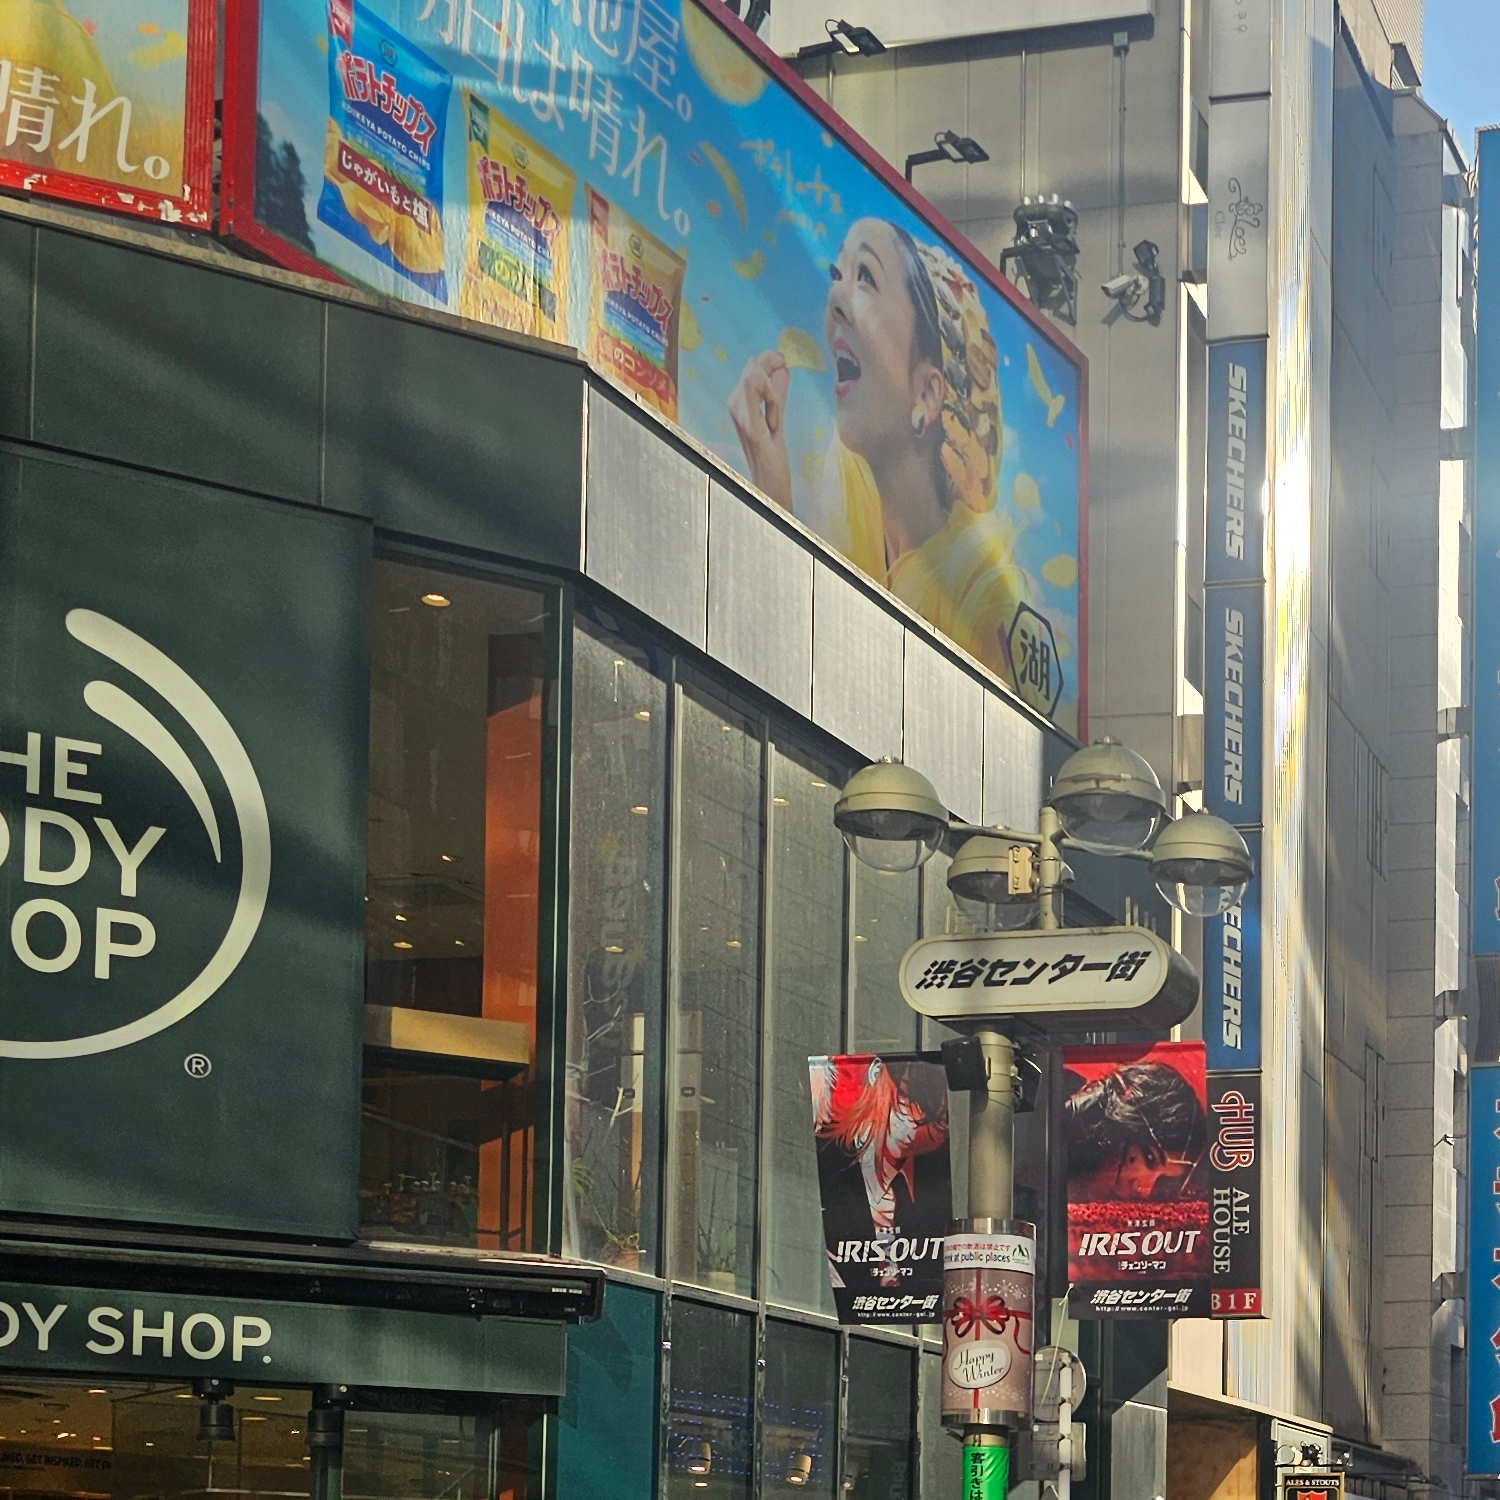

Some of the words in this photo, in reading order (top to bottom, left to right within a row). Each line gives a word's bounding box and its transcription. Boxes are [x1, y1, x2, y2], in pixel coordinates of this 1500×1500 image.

[377, 127, 407, 154] POTATO
[341, 149, 429, 230] じゃがいもと塩
[1223, 362, 1247, 562] SKECHERS
[1018, 627, 1051, 702] 湖
[1222, 606, 1246, 805] SKECHERS
[0, 806, 166, 898] DY
[916, 951, 1151, 991] 渋谷センター街
[1220, 885, 1244, 1051] KECHERS
[1210, 1090, 1254, 1171] HUB
[1214, 1188, 1231, 1274] HOUSE
[1232, 1187, 1249, 1236] ALE
[889, 1237, 945, 1263] OUT
[961, 1252, 983, 1264] public
[985, 1252, 1011, 1264] places
[1079, 1232, 1141, 1256] IRIS
[1141, 1230, 1201, 1256] OUT
[852, 1295, 939, 1311] 渋谷センター街
[1090, 1288, 1193, 1305] 渋谷センター街
[85, 1306, 271, 1361] SHOP
[954, 1349, 995, 1372] Happy
[963, 1366, 1004, 1384] Winter
[1311, 1478, 1340, 1486] STOUTS
